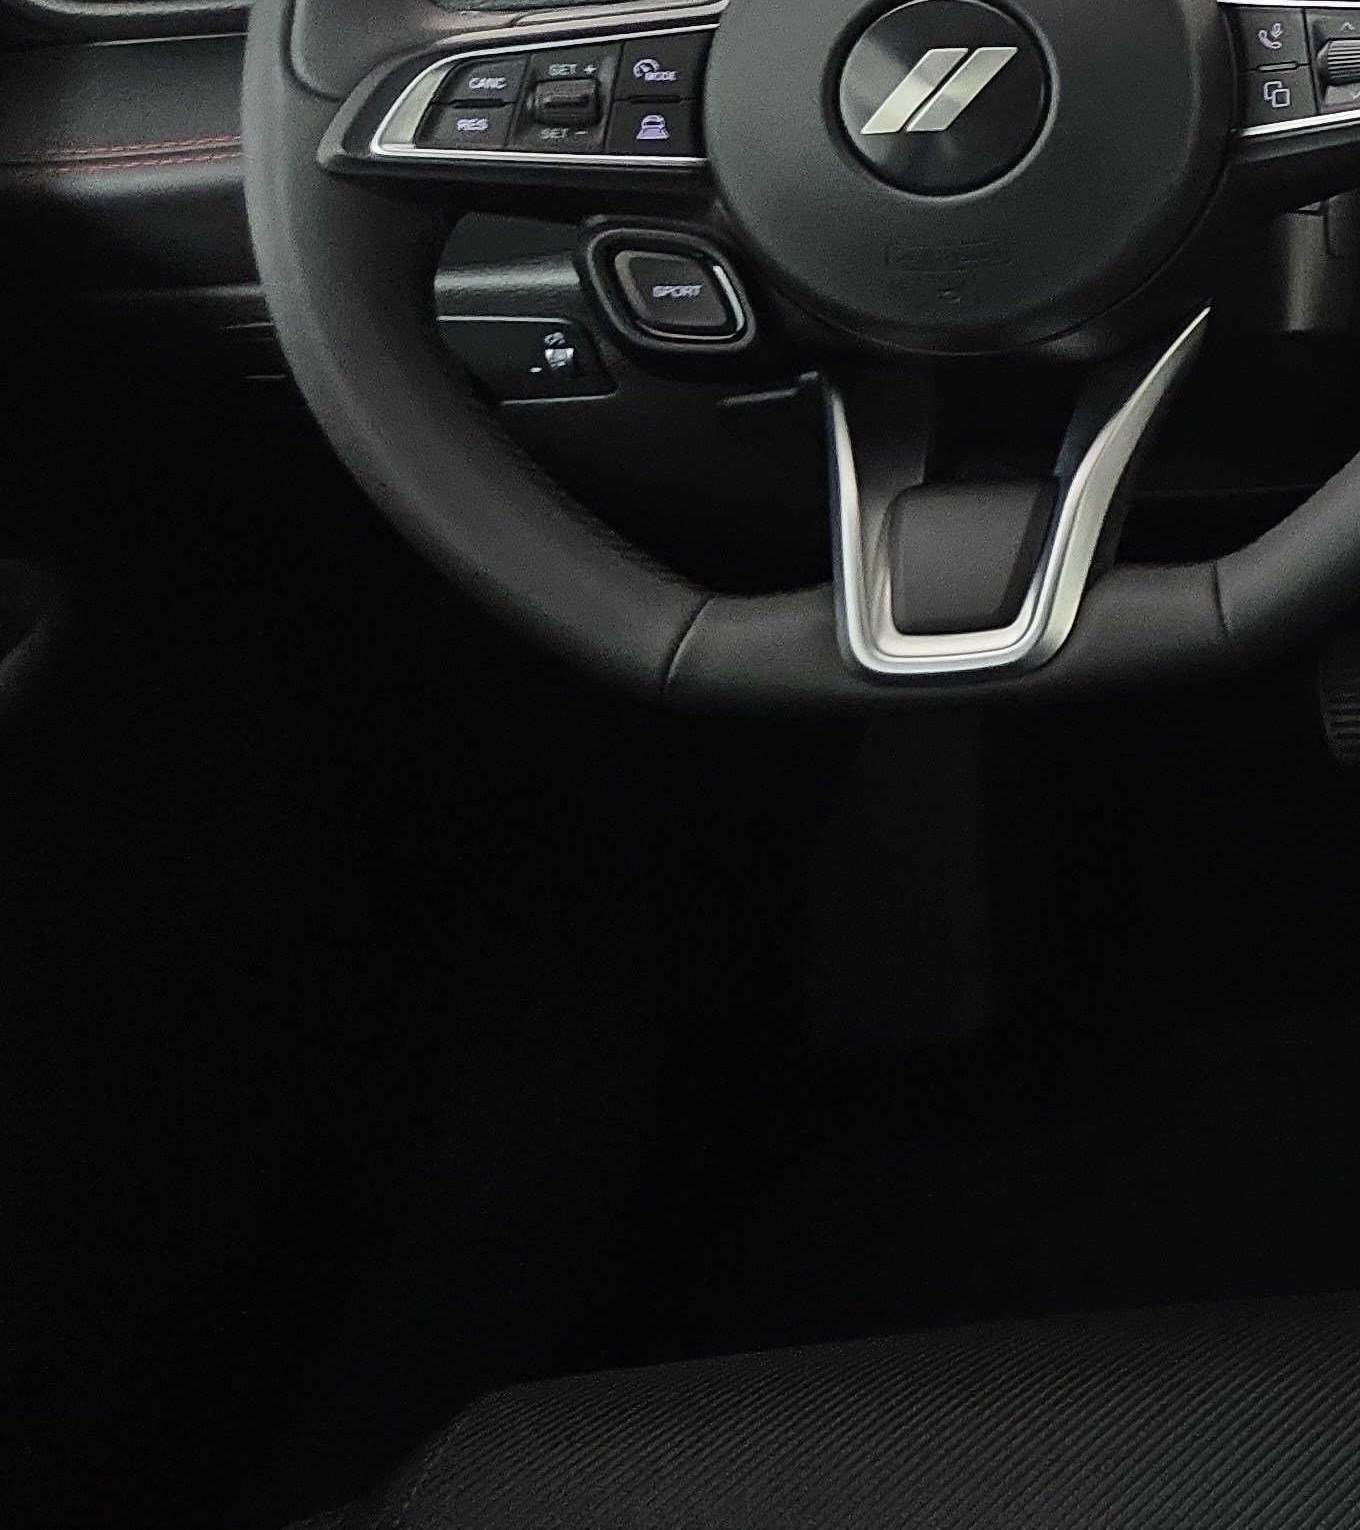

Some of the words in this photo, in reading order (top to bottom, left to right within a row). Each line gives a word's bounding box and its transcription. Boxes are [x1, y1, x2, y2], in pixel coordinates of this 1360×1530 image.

[548, 63, 577, 76] SET
[468, 76, 506, 90] CANC
[645, 71, 677, 82] MODE
[456, 118, 489, 132] RES
[540, 127, 569, 140] SET
[652, 284, 702, 298] SPORT
